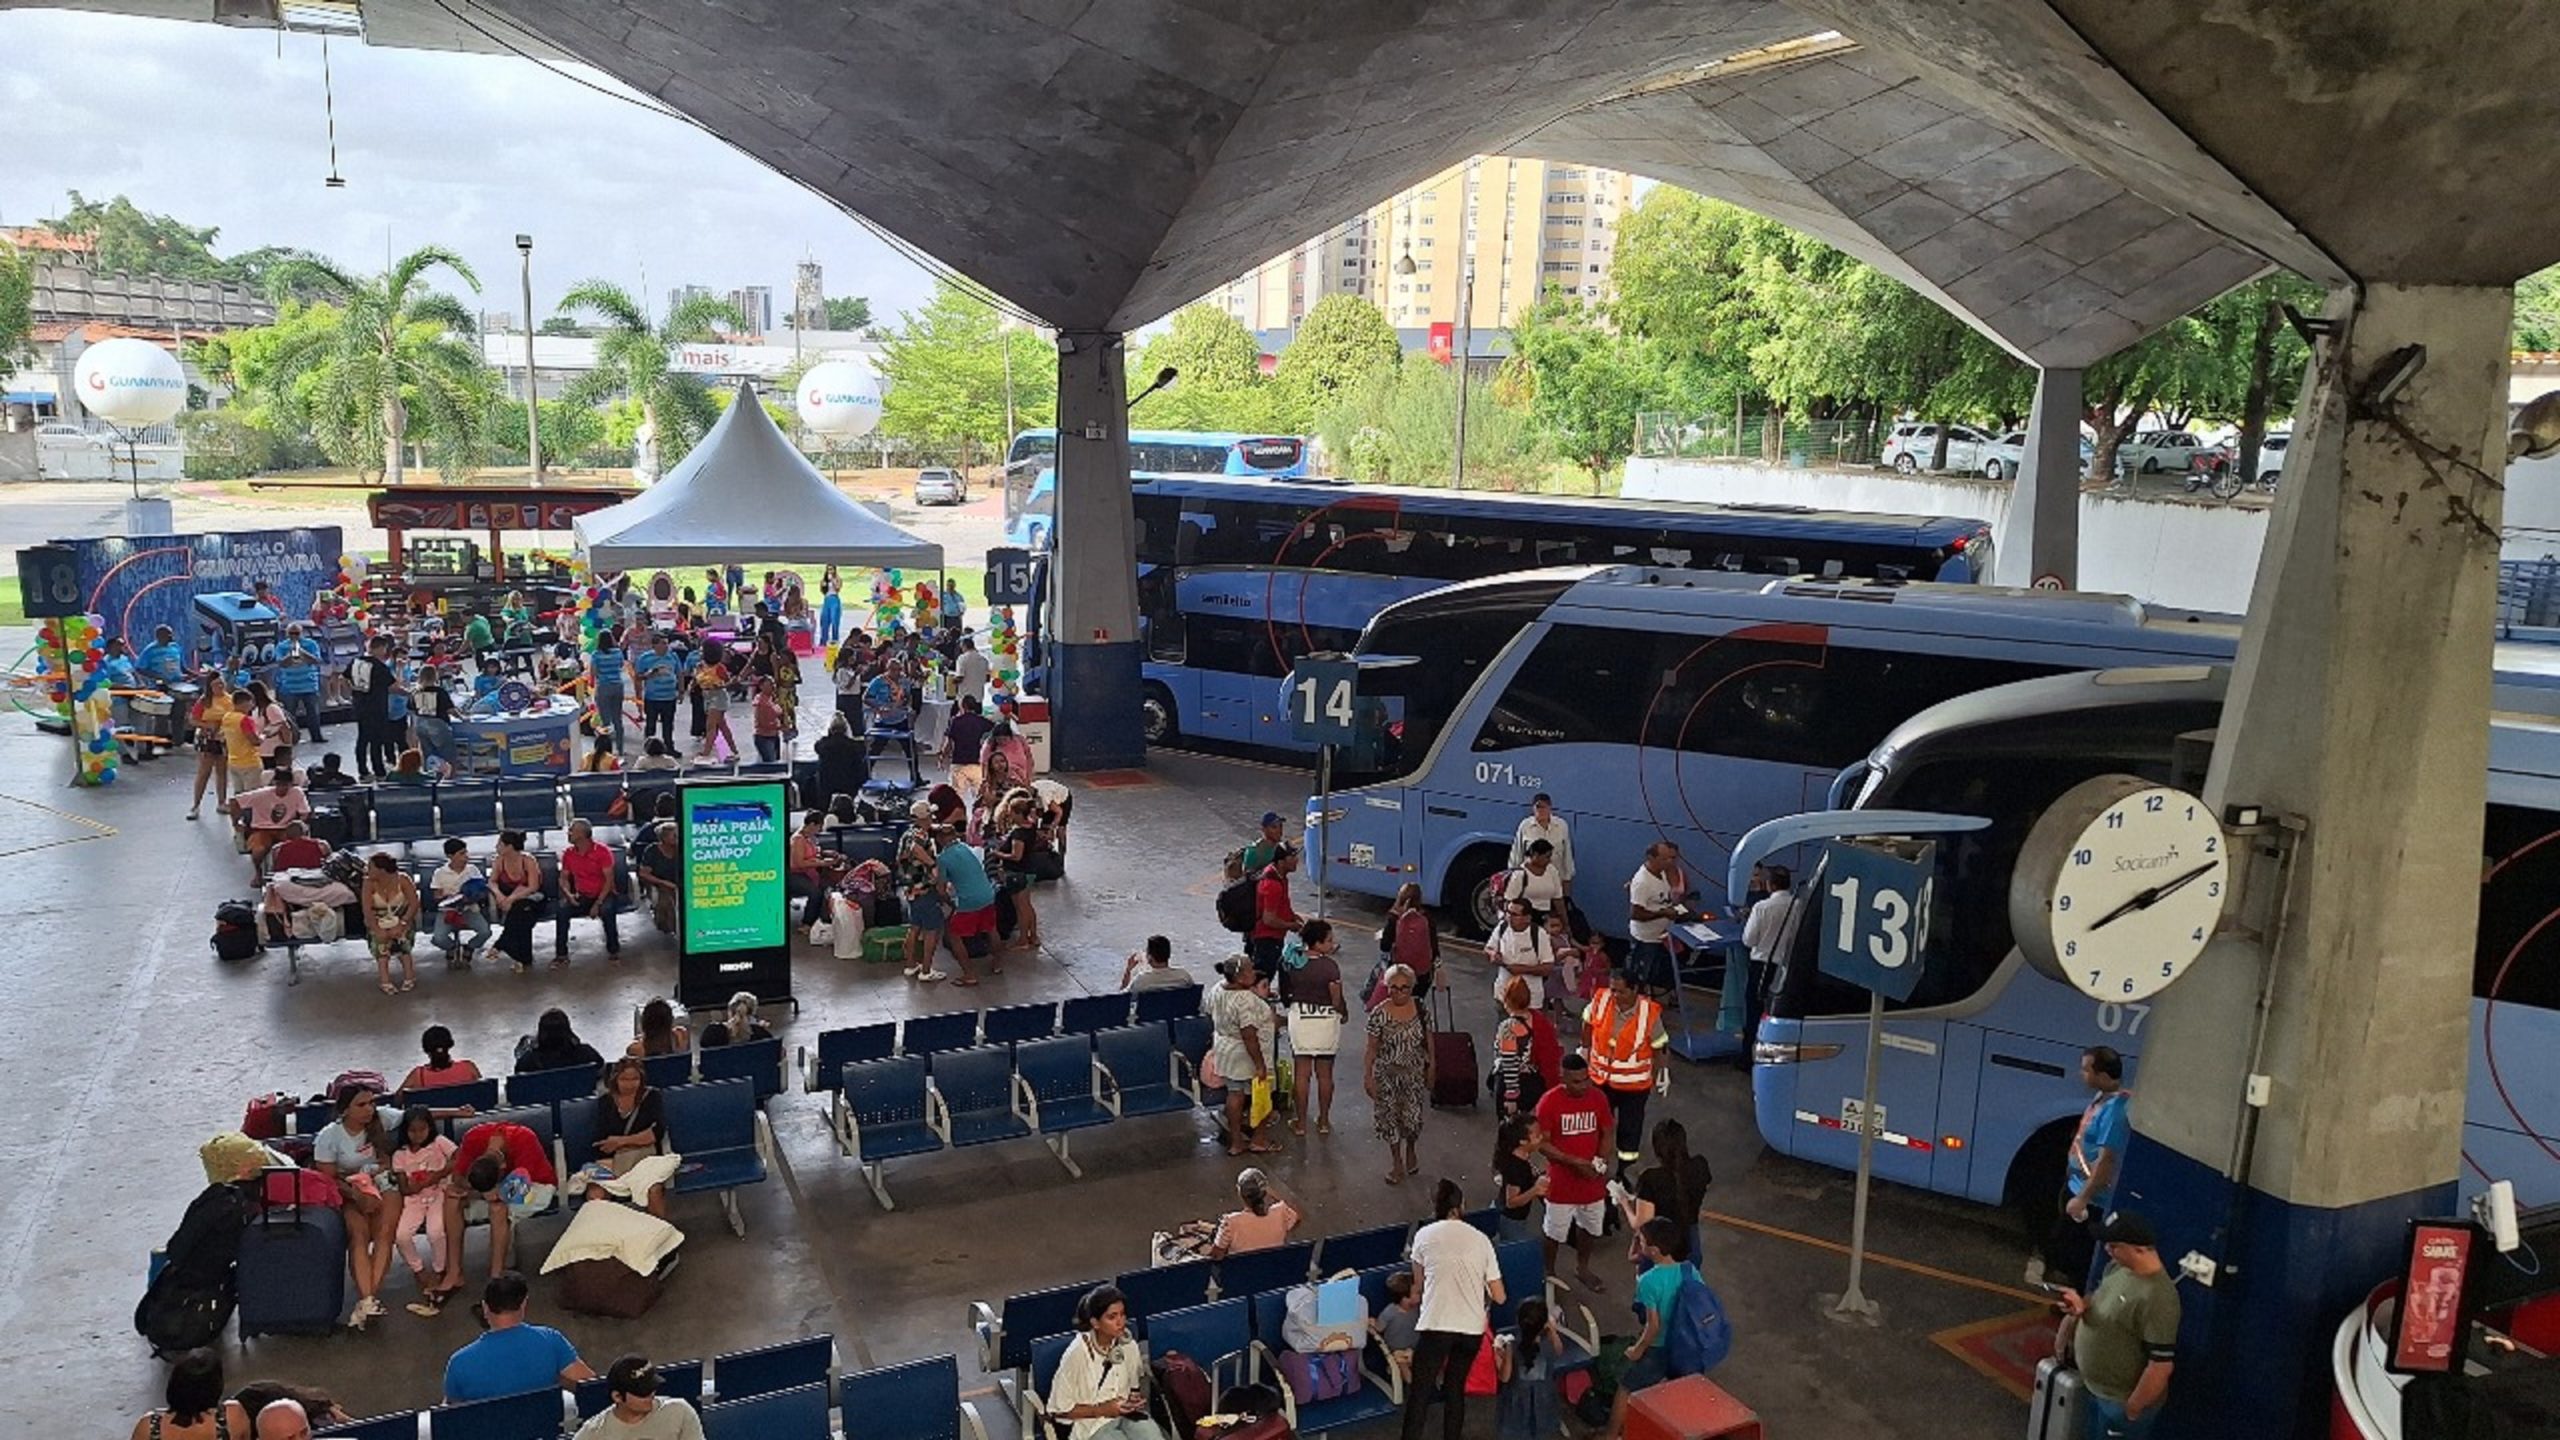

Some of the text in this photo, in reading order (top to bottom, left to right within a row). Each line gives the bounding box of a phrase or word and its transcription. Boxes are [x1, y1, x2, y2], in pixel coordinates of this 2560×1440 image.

[683, 349, 729, 367] mais
[30, 562, 79, 604] 18
[990, 562, 1029, 595] 15
[1297, 677, 1354, 727] 14
[1475, 761, 1515, 785] 071
[2144, 796, 2163, 812] 12
[2106, 812, 2124, 828] 11
[2185, 806, 2195, 821] 1
[691, 822, 729, 835] PARA
[742, 833, 763, 845] OU
[2205, 837, 2217, 853] 2
[691, 846, 752, 861] CAMPO?
[2073, 850, 2092, 866] 10
[2208, 882, 2220, 898] 3
[2059, 896, 2071, 911] 9
[1830, 876, 1910, 968] 13
[1911, 875, 1933, 964] 13
[2192, 926, 2203, 941] 4
[2065, 940, 2077, 956] 8
[2161, 961, 2173, 977] 5
[2090, 970, 2101, 986] 7
[2123, 977, 2134, 993] 6
